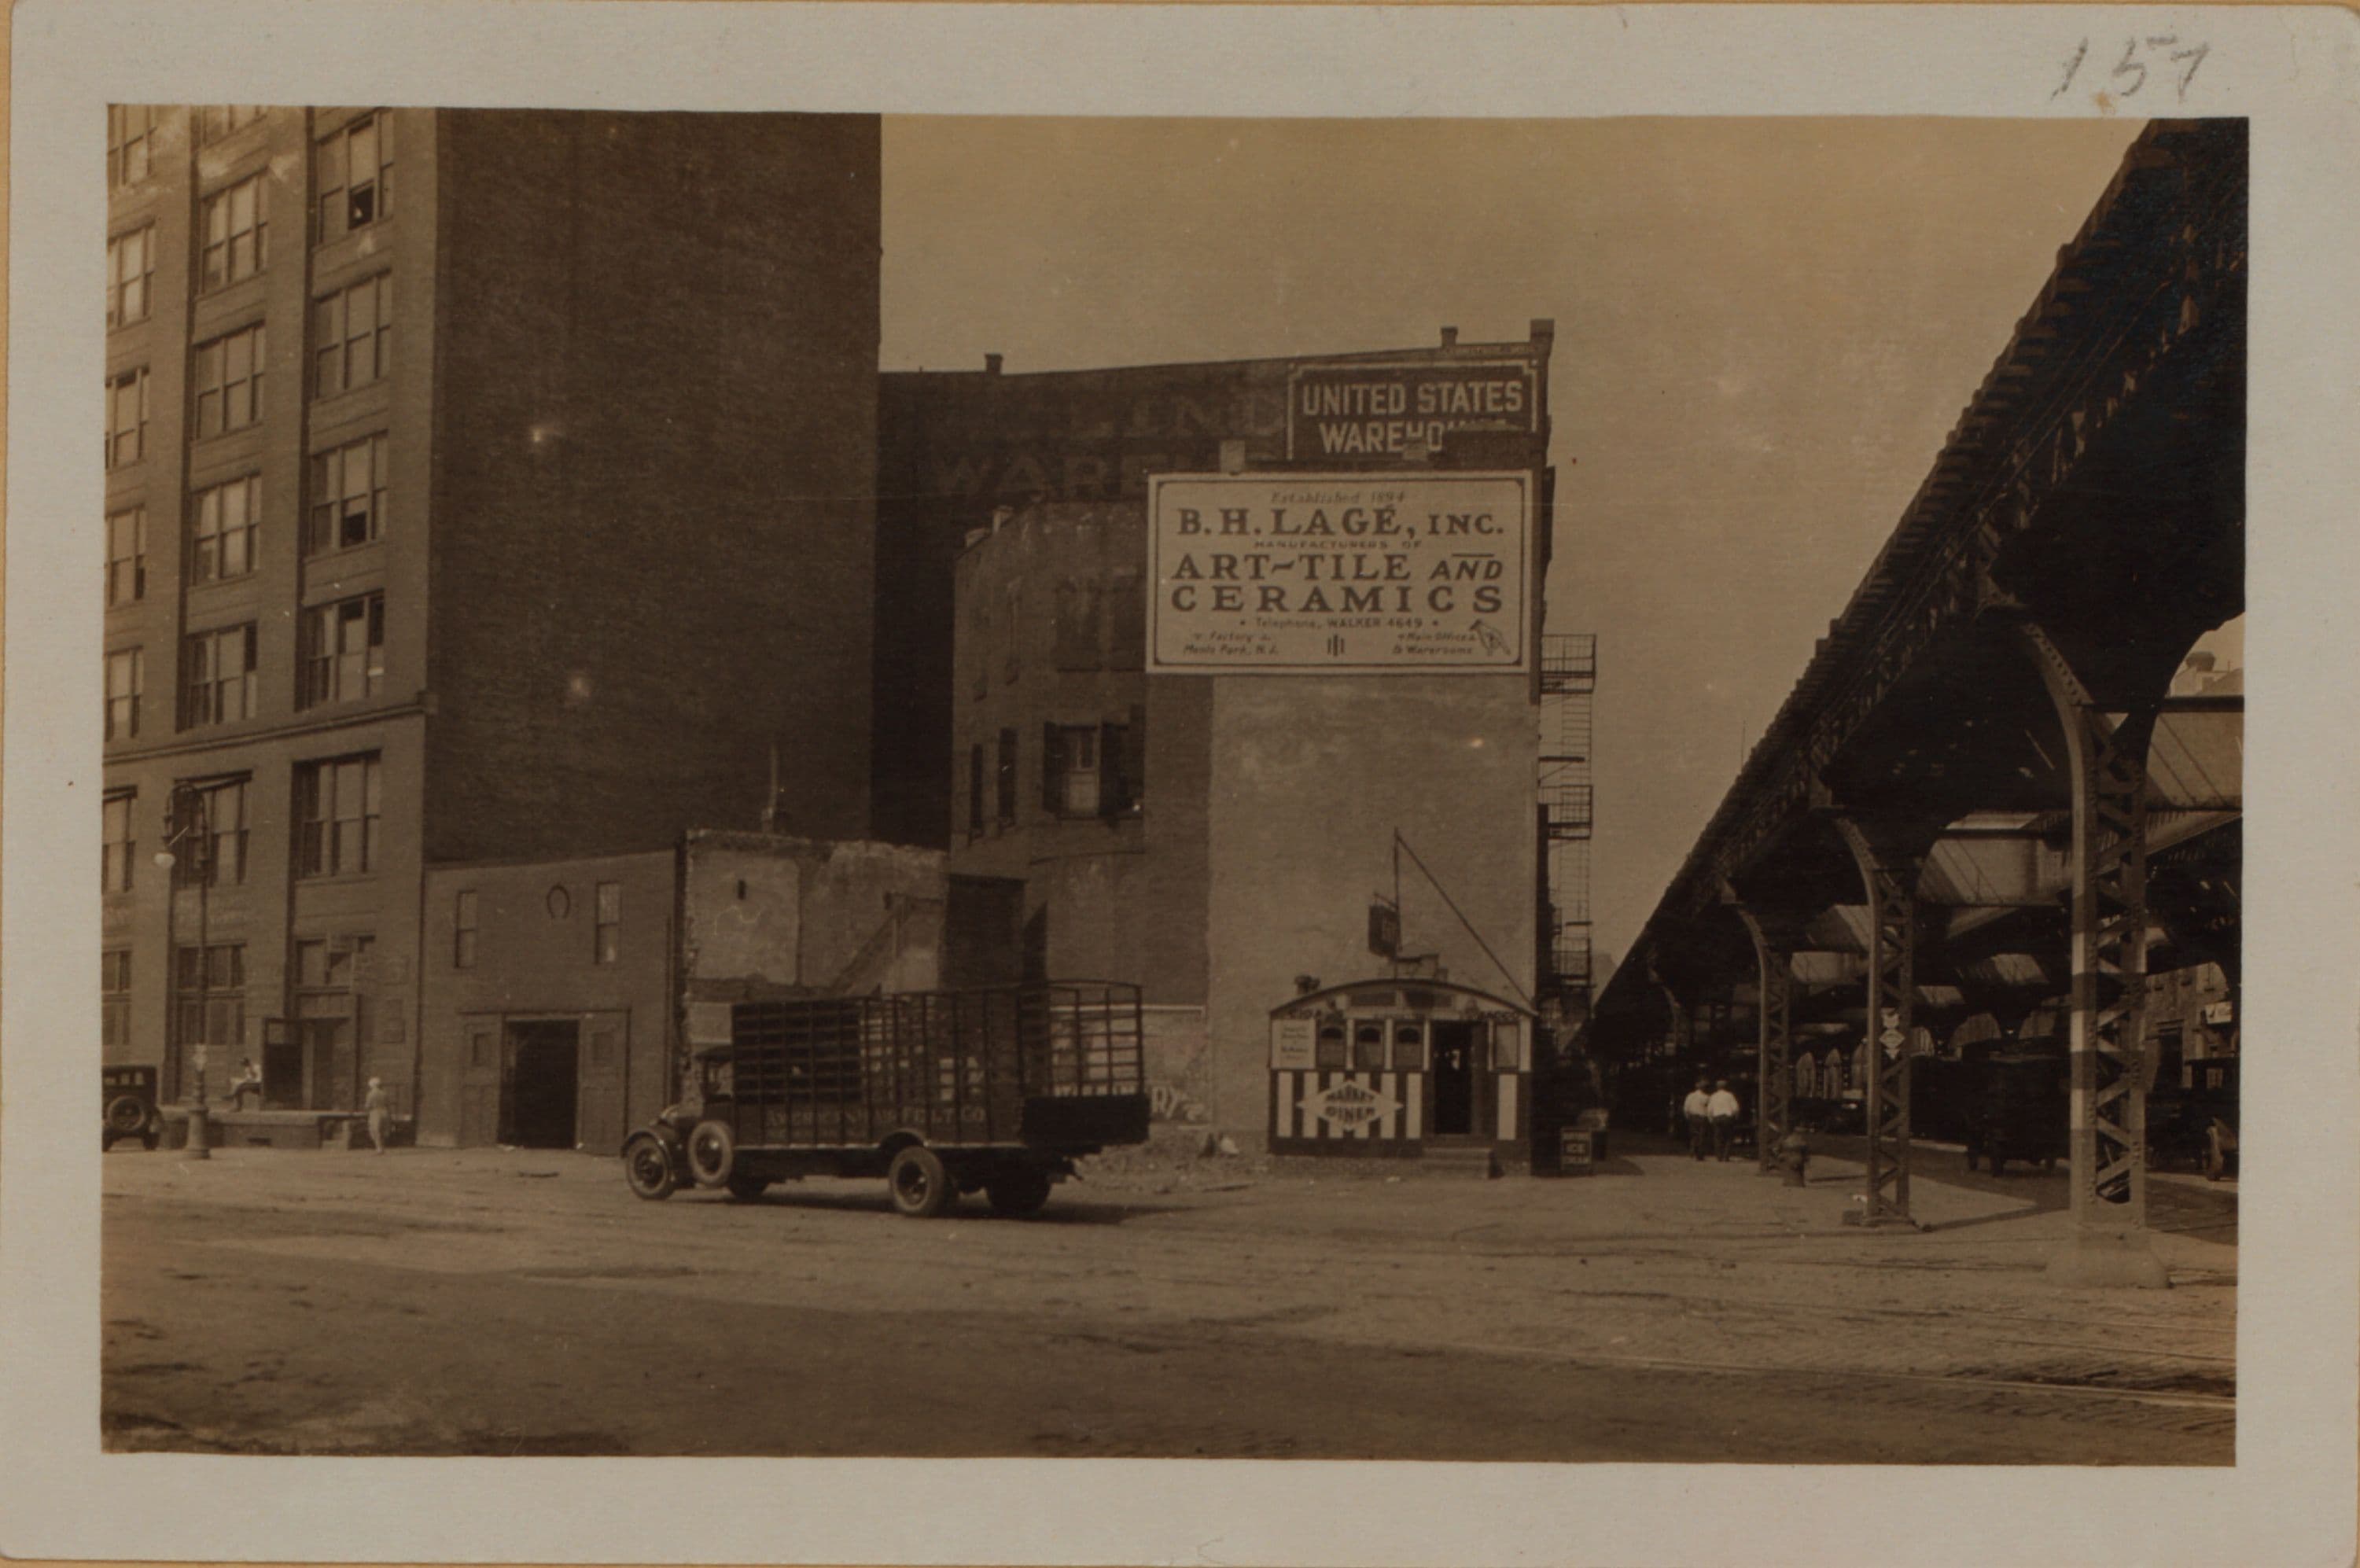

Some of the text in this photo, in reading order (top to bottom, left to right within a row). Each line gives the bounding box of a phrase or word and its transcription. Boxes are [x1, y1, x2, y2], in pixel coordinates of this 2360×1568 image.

[2050, 35, 2211, 105] 157
[1302, 381, 1523, 416] UNITED STATES
[1270, 491, 1360, 504] Established
[1427, 513, 1504, 536] INC.
[1254, 539, 1422, 549] MANUFACTURERS OF
[1430, 558, 1503, 580] AND
[1171, 585, 1503, 613] CERAMICS
[1327, 617, 1381, 629] WALKER
